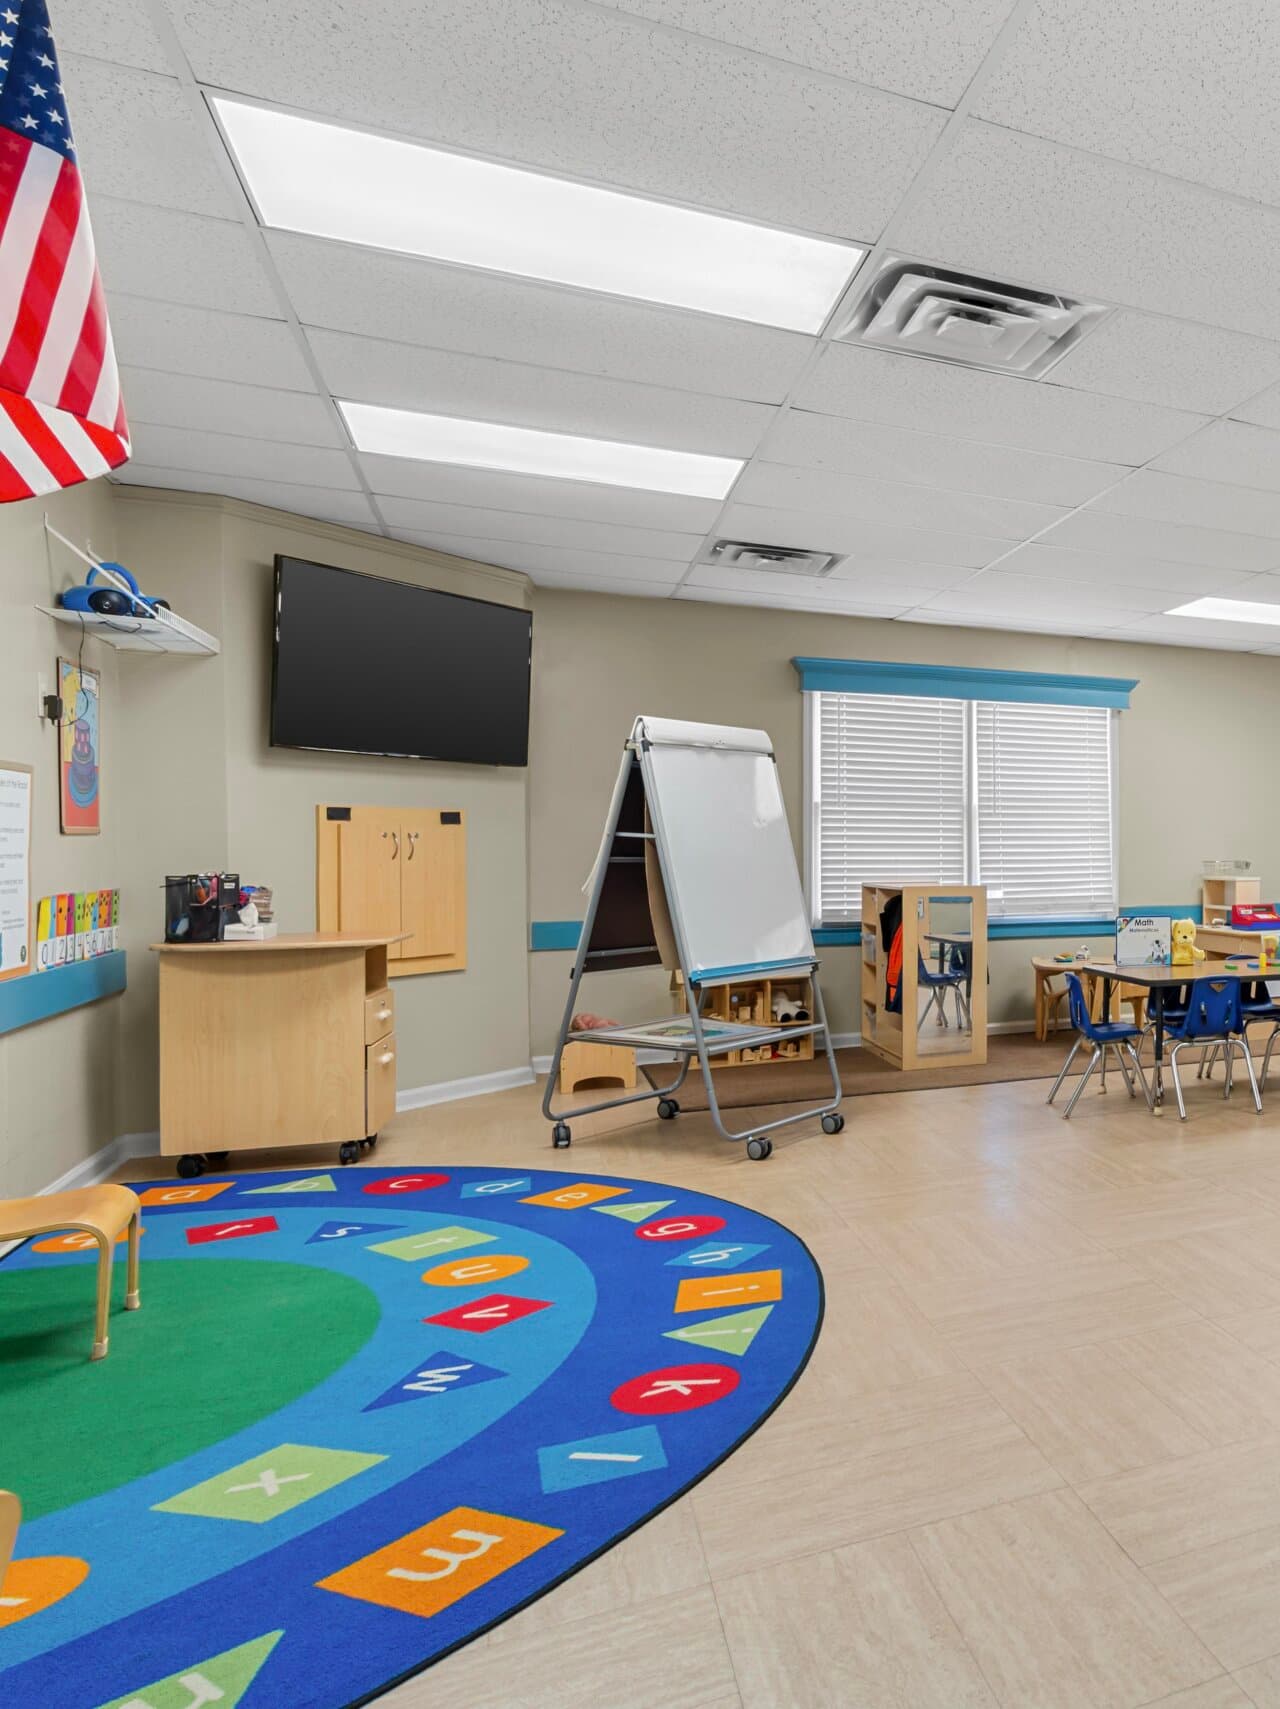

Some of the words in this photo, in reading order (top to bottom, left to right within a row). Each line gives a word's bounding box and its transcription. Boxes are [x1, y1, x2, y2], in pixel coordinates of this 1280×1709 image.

[1134, 918, 1154, 927] Math
[389, 1178, 423, 1189] c
[475, 1180, 524, 1193] d
[160, 1189, 201, 1201] a
[553, 1191, 589, 1203] e
[320, 1226, 362, 1238] s
[642, 1221, 698, 1237] g
[688, 1246, 743, 1265] h
[702, 1284, 760, 1297] i
[462, 1302, 509, 1319] v
[676, 1327, 756, 1338] j
[402, 1363, 474, 1393] w
[640, 1378, 721, 1399] k
[223, 1468, 313, 1497] x
[386, 1529, 504, 1582] m
